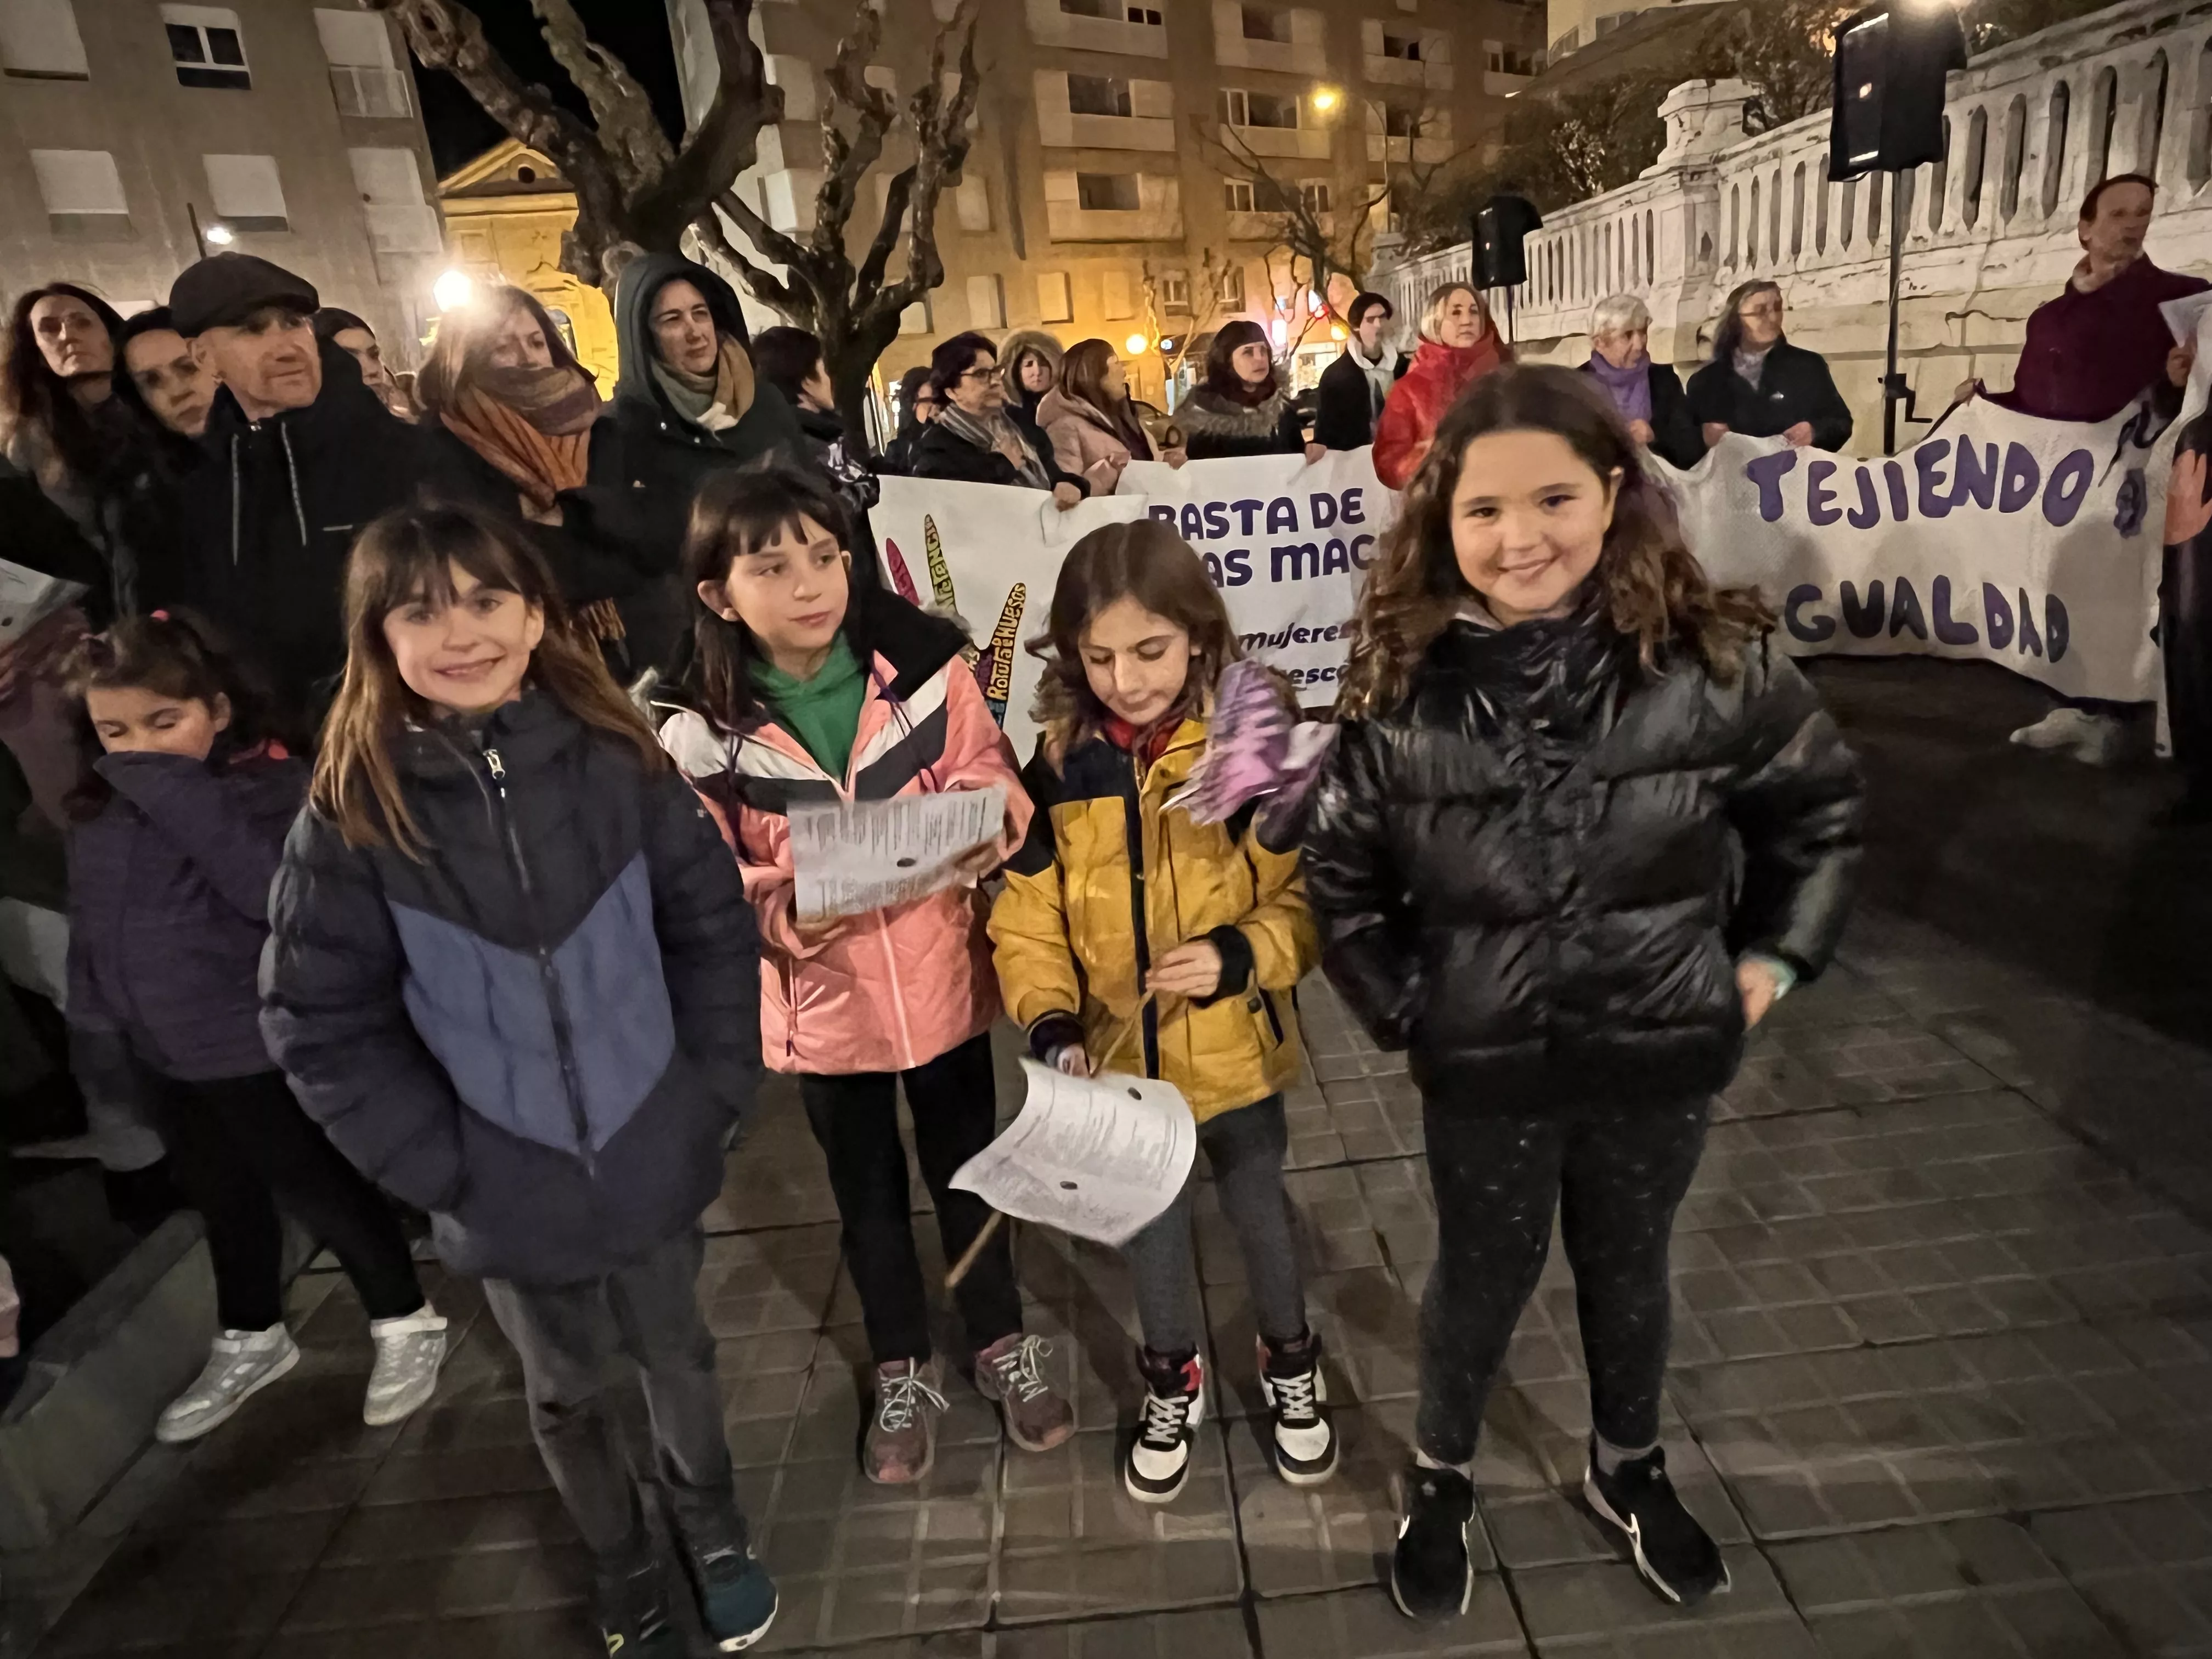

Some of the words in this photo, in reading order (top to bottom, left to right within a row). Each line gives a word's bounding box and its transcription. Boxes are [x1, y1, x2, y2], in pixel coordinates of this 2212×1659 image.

[1310, 487, 1366, 529] DE
[1746, 433, 2095, 529] TEJIENDO
[1201, 549, 1253, 588] AS
[1270, 534, 1376, 583] MAC
[1784, 574, 2070, 663] GUALDAD
[1288, 664, 1350, 685] esc
